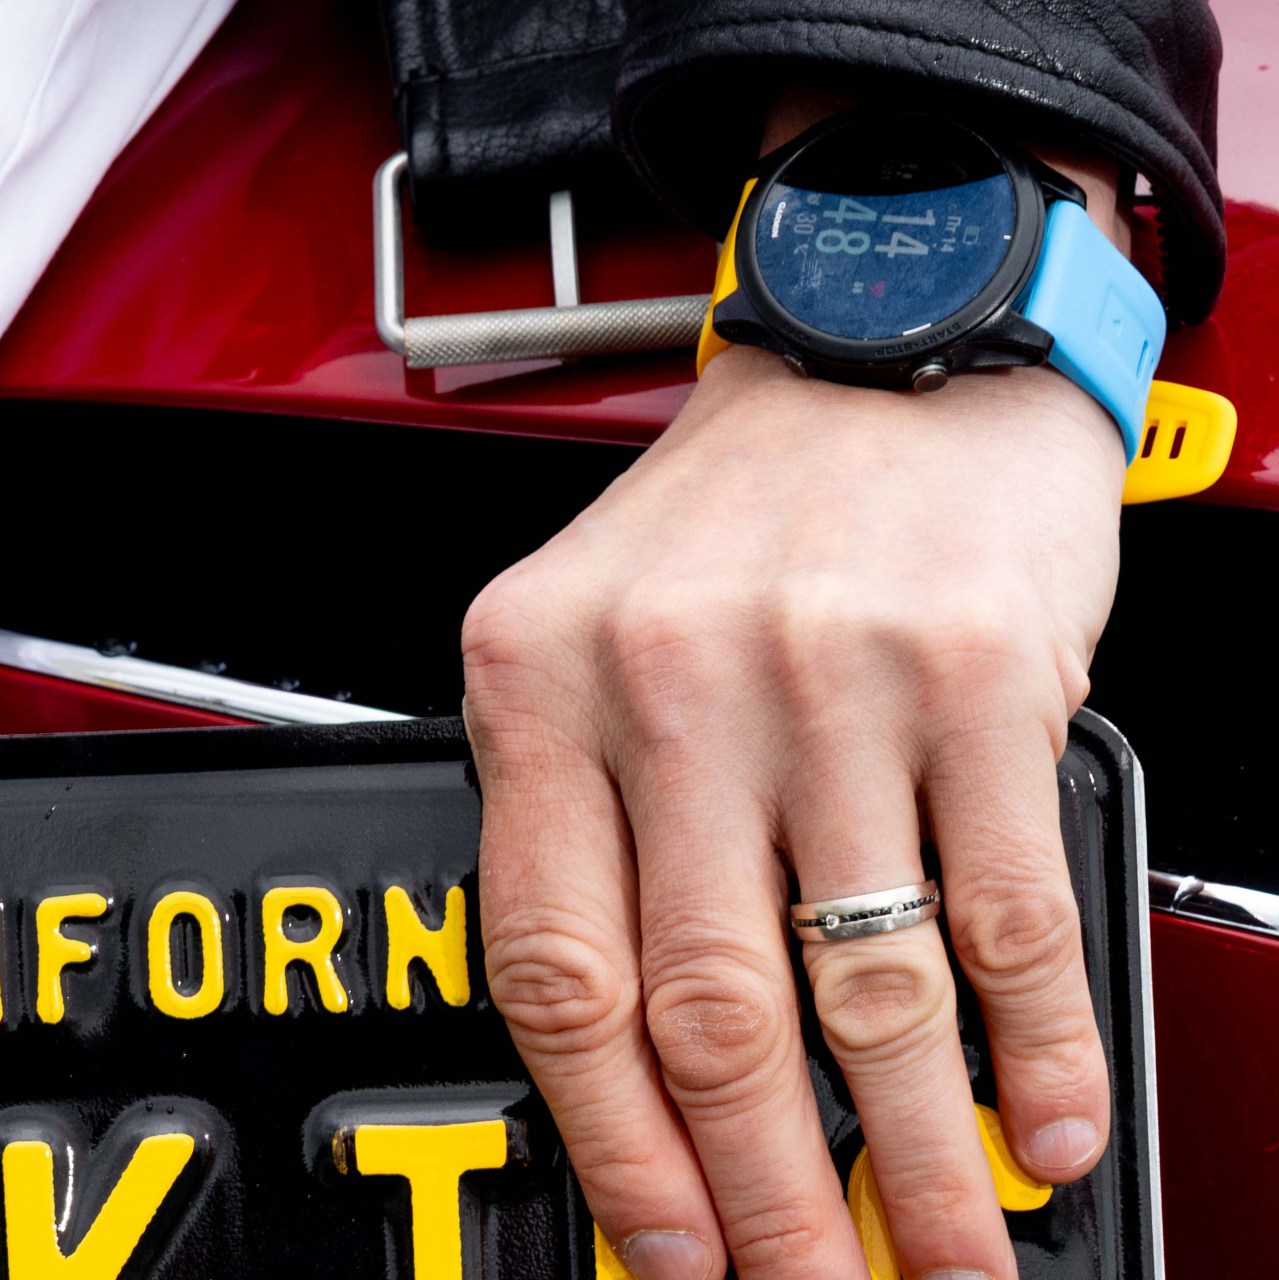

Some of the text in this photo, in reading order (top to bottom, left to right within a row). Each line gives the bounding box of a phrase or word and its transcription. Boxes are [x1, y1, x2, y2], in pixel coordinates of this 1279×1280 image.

[771, 201, 786, 238] GARMIN
[793, 213, 817, 235] 30
[815, 197, 877, 255] 48
[875, 209, 936, 258] 14
